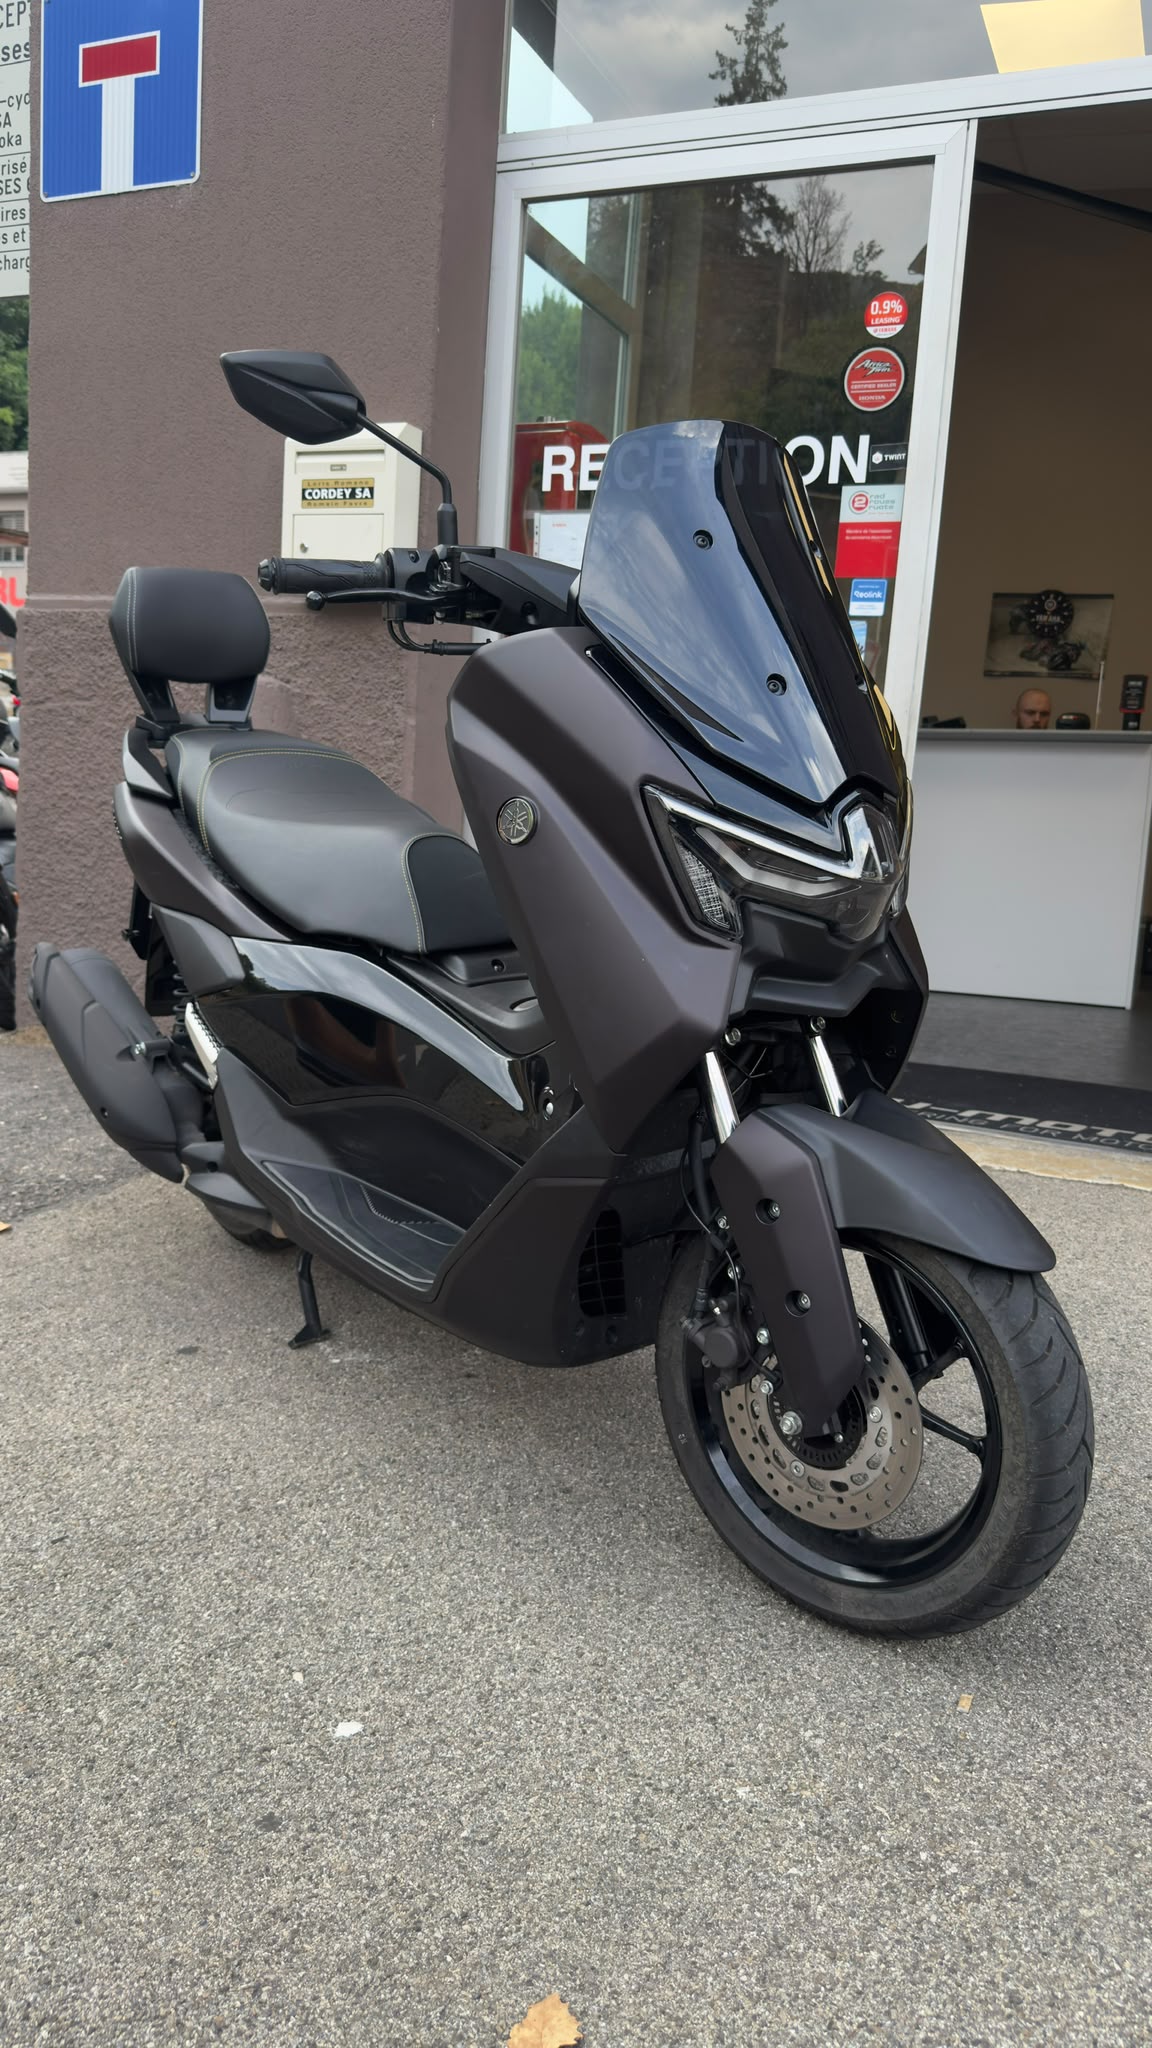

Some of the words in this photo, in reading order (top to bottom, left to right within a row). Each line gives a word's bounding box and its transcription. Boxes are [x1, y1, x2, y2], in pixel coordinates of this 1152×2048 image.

[0, 0, 30, 28] EP
[0, 111, 12, 129] A
[1, 156, 27, 176] risé
[1, 206, 26, 222] ires
[13, 227, 26, 244] et
[870, 299, 903, 315] 0.9%
[541, 434, 871, 492] RECETION
[884, 453, 906, 462] TWINT
[304, 488, 352, 500] CORDEY
[355, 487, 371, 499] SA
[853, 496, 867, 508] 2
[1000, 1123, 1062, 1138] FOR
